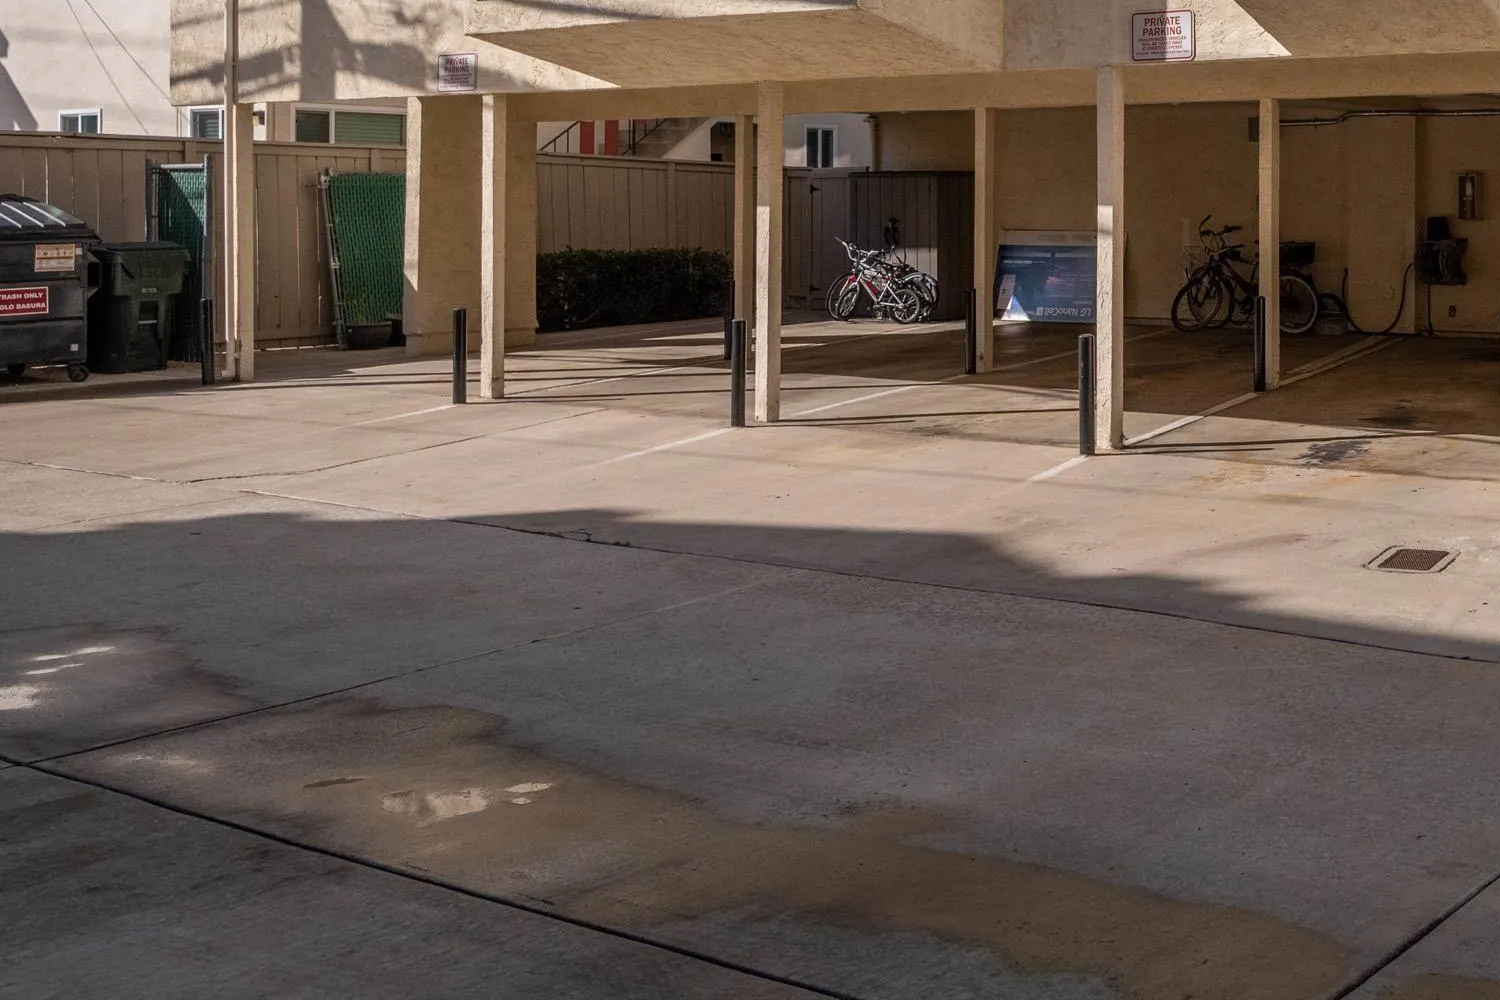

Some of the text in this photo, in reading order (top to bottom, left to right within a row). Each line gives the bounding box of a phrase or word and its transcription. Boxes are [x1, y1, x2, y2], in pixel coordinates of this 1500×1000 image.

[1144, 16, 1180, 26] PRIVATE
[1142, 26, 1182, 36] PARKING
[445, 57, 468, 66] PRIVATE
[444, 65, 469, 73] PARKING
[1080, 308, 1091, 317] LG
